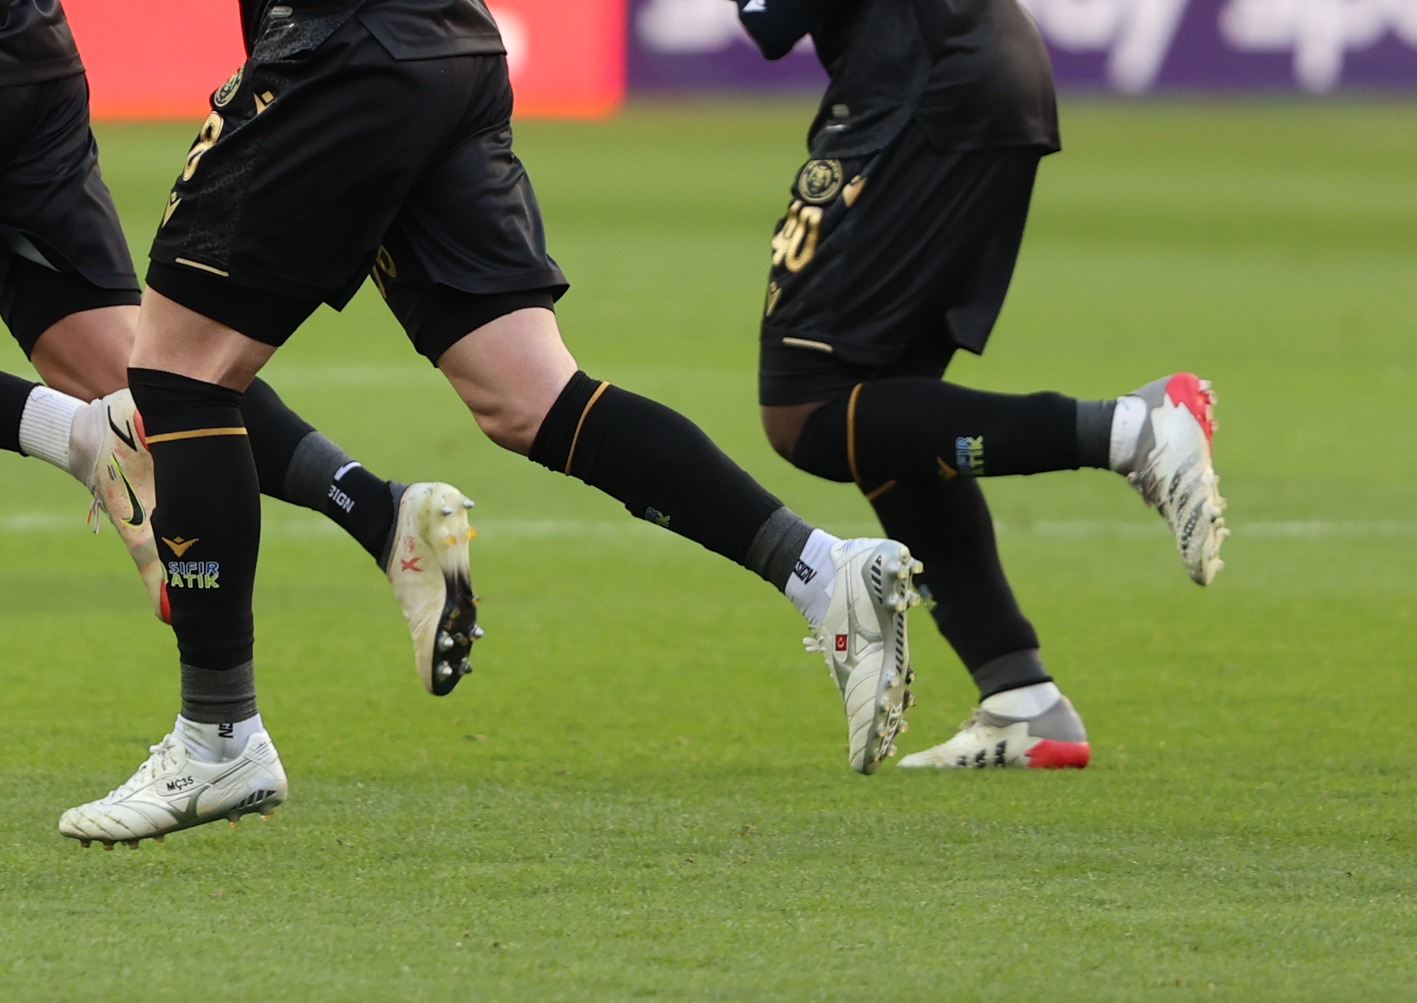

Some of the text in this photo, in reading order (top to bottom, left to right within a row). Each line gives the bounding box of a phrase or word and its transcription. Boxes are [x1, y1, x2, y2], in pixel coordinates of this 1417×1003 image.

[772, 200, 824, 273] 40
[168, 561, 220, 575] SIFIR
[171, 574, 220, 589] ATIK
[166, 775, 194, 792] MÇ35
